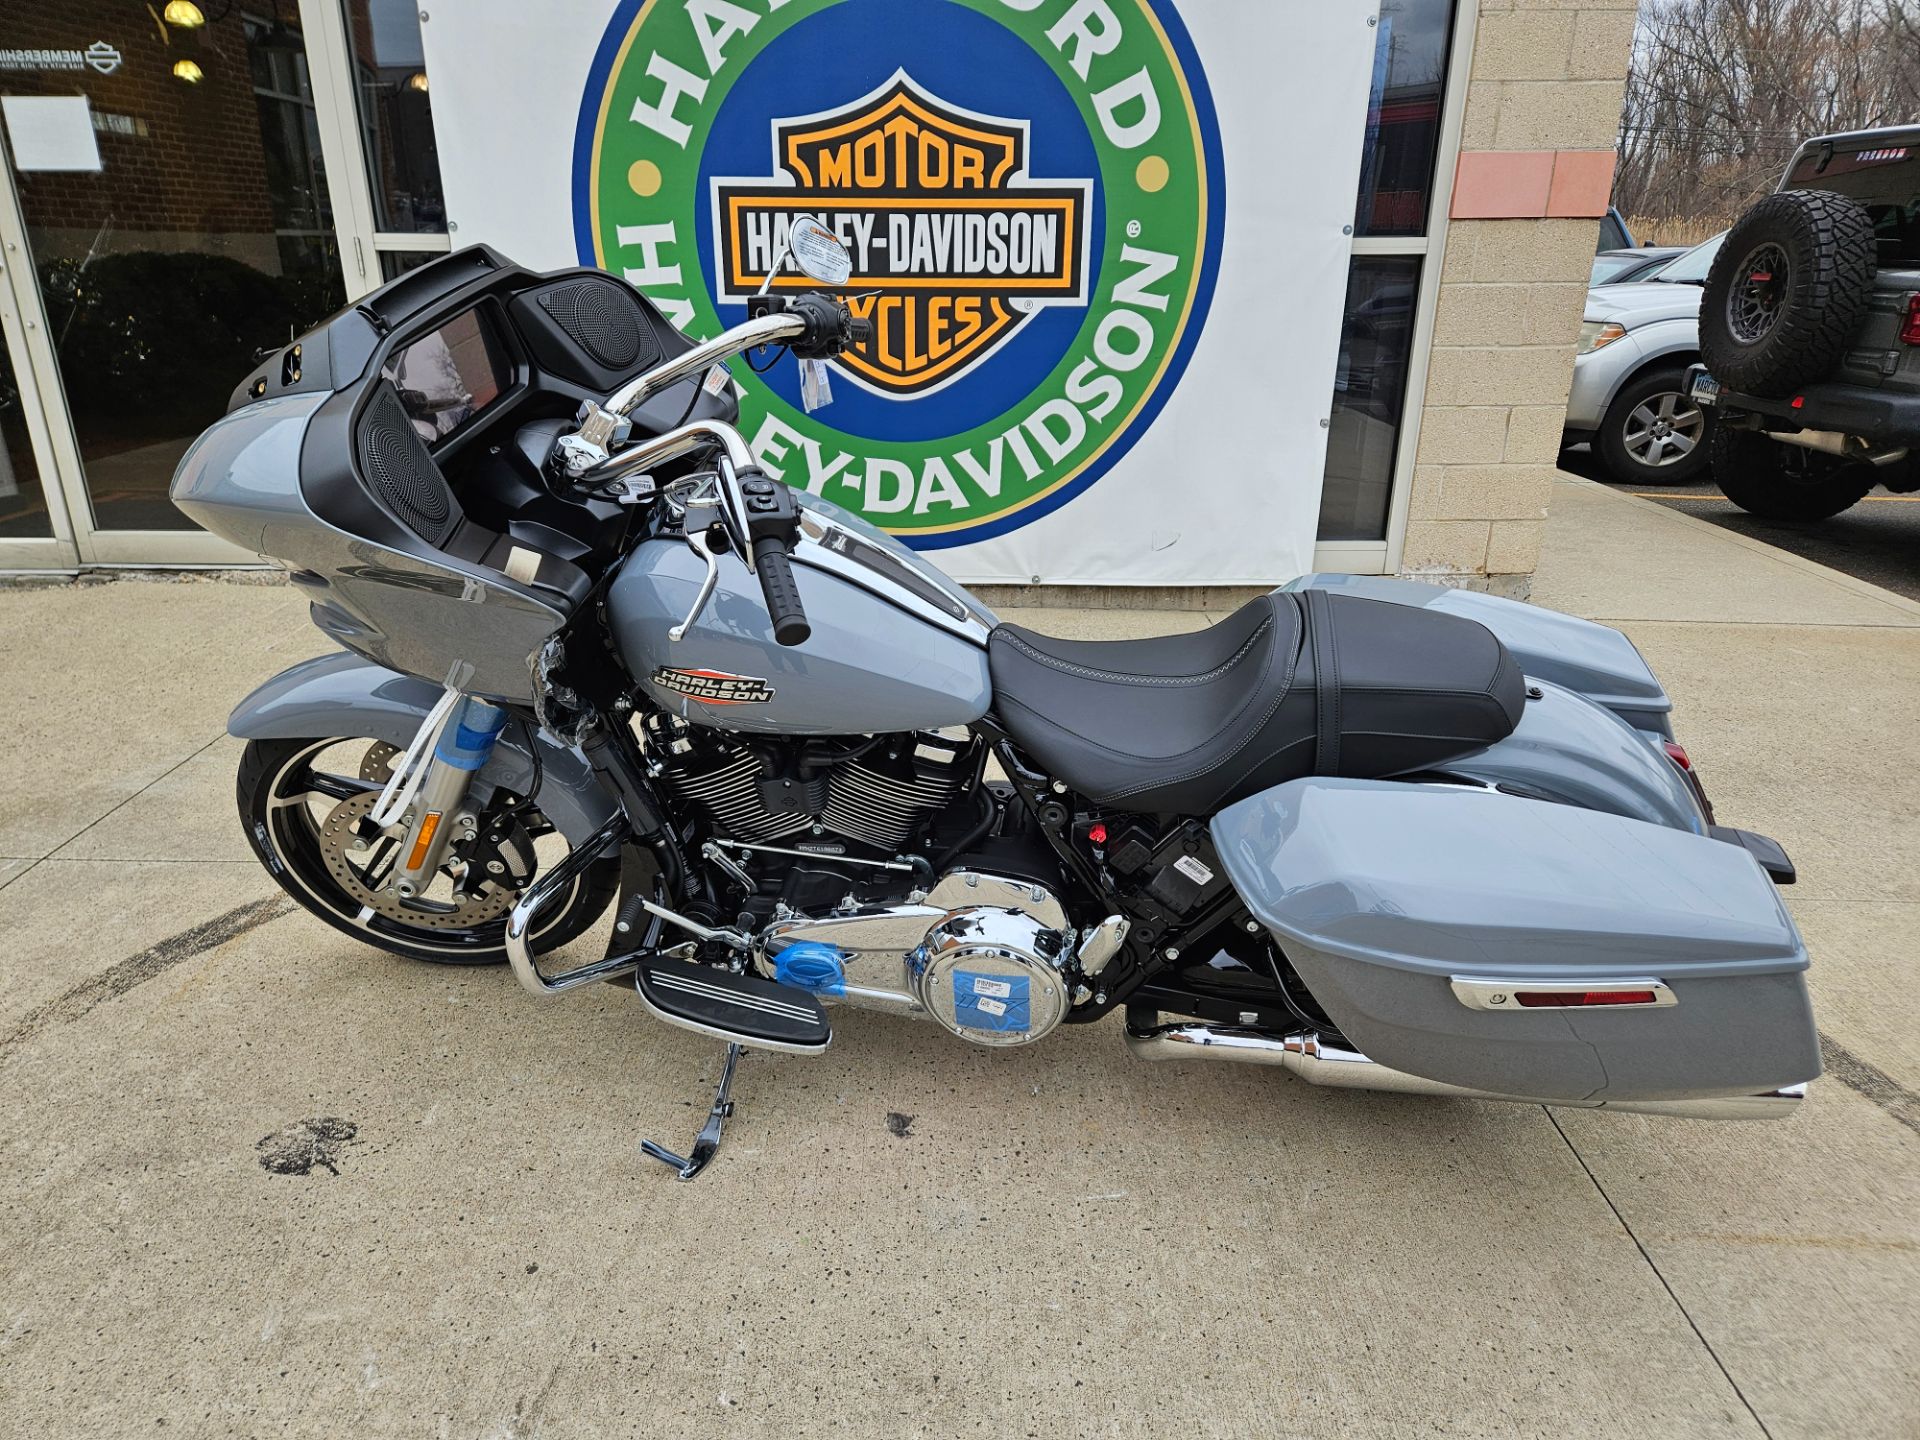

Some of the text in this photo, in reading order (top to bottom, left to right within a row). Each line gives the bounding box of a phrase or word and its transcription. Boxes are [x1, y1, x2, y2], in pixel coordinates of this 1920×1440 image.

[819, 115, 985, 189] MOTOR
[746, 212, 1057, 274] HAEY-DAVIDSON
[836, 295, 983, 372] YCLES
[654, 676, 769, 701] DAVIDSON
[662, 670, 761, 691] HARLEY-
